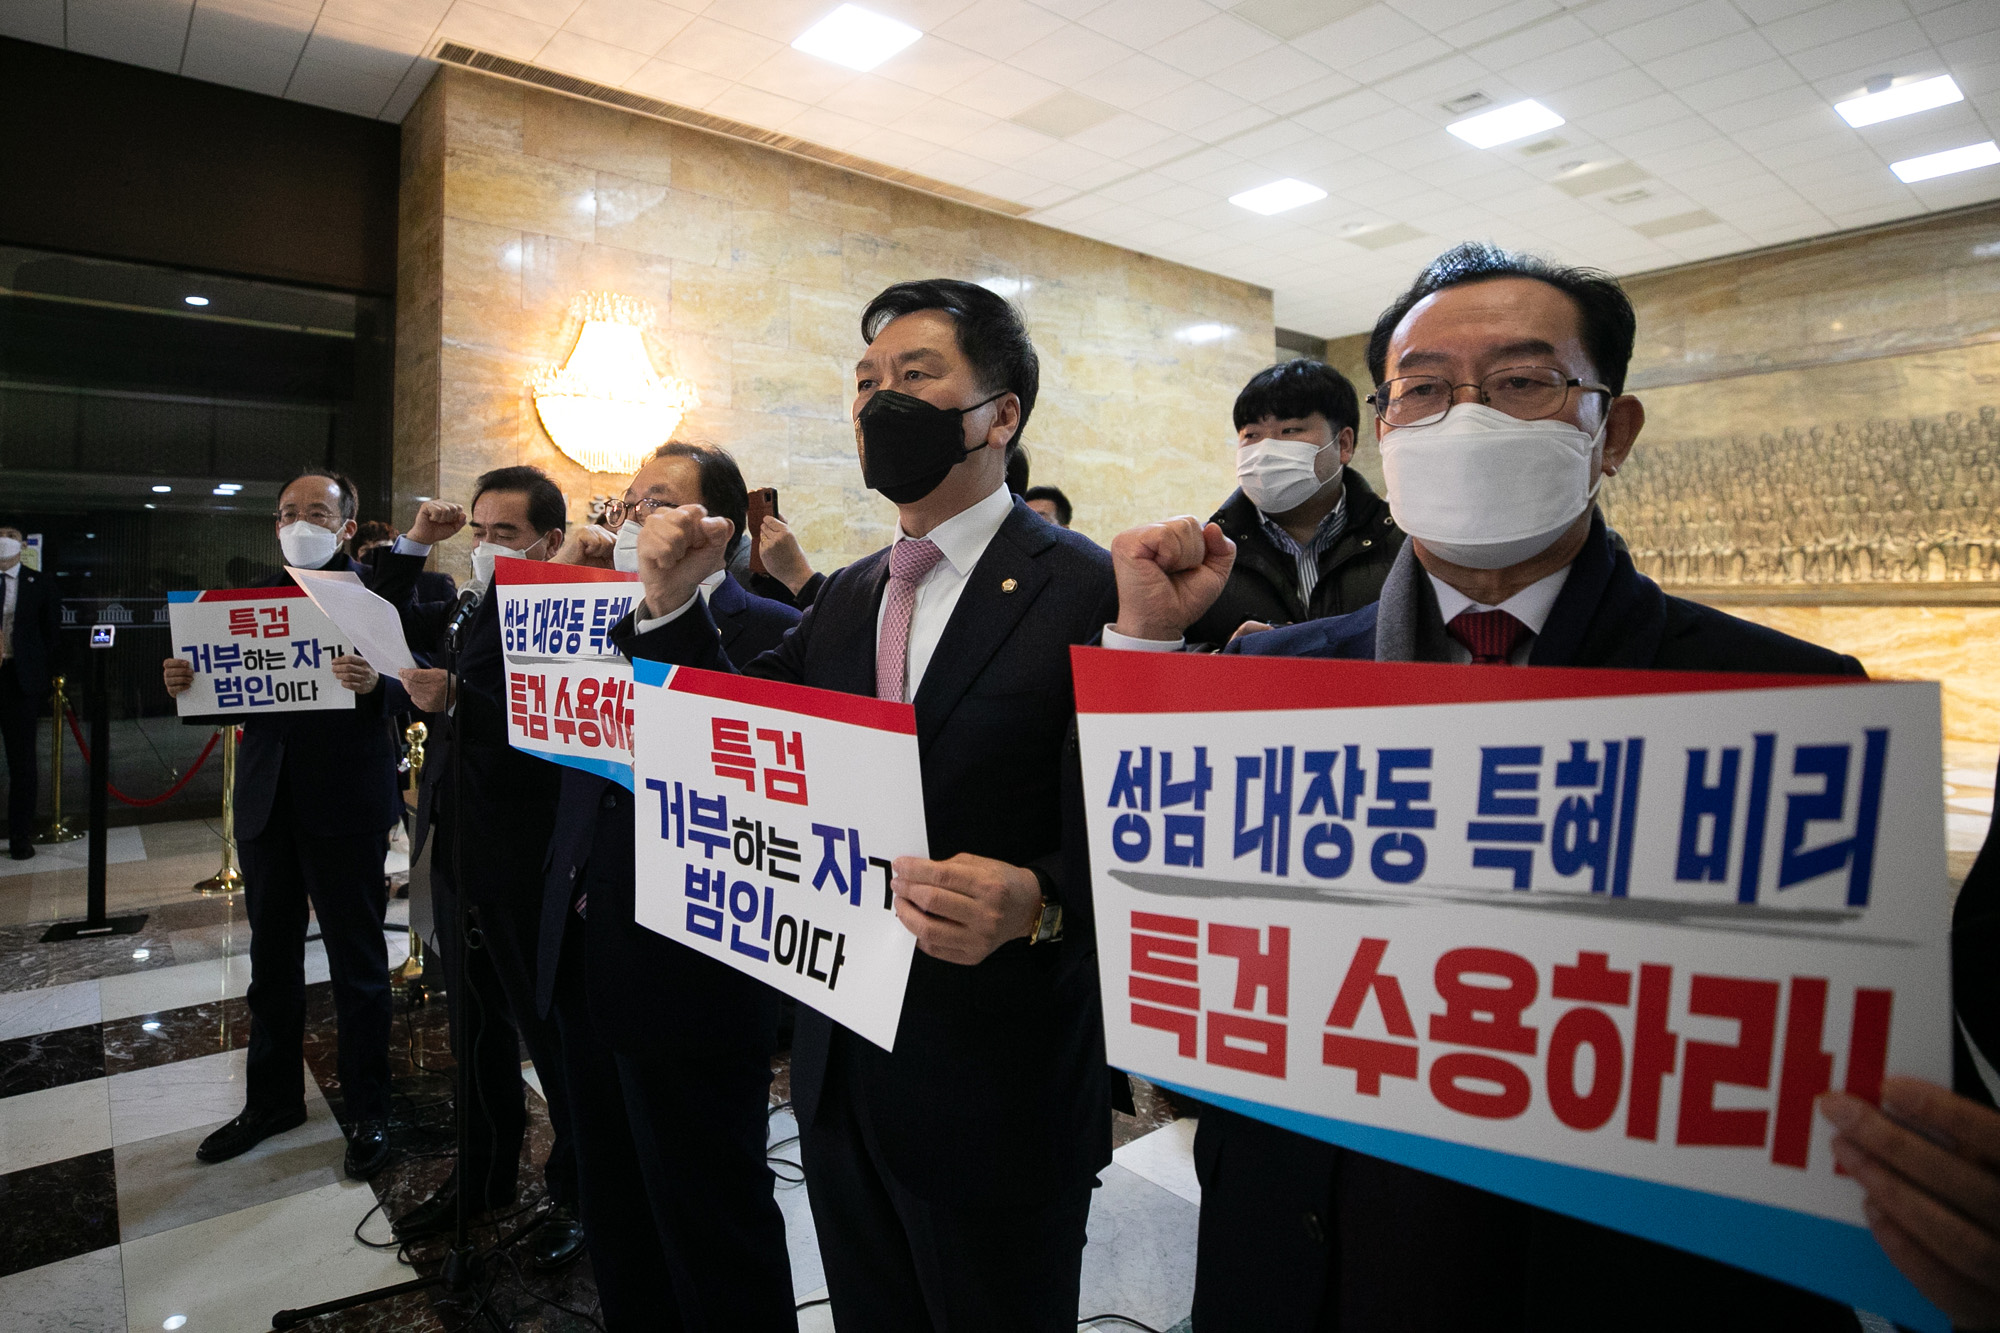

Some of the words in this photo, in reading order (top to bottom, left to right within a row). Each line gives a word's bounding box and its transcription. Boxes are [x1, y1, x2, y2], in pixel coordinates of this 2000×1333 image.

[181, 643, 286, 674] 거부하는
[229, 606, 290, 639] 특검
[504, 599, 529, 652] 성남
[532, 598, 586, 654] 대장동
[214, 674, 319, 708] 범인이다
[510, 672, 549, 741] 특검
[711, 717, 808, 806] 특검
[645, 778, 801, 883] 거부하는
[1107, 746, 1213, 868] 성남
[1233, 744, 1437, 884] 대장동
[1466, 738, 1645, 899] 특혜
[1675, 728, 1891, 907] 비리
[685, 863, 845, 991] 범인이다
[1128, 910, 1291, 1080] 특검
